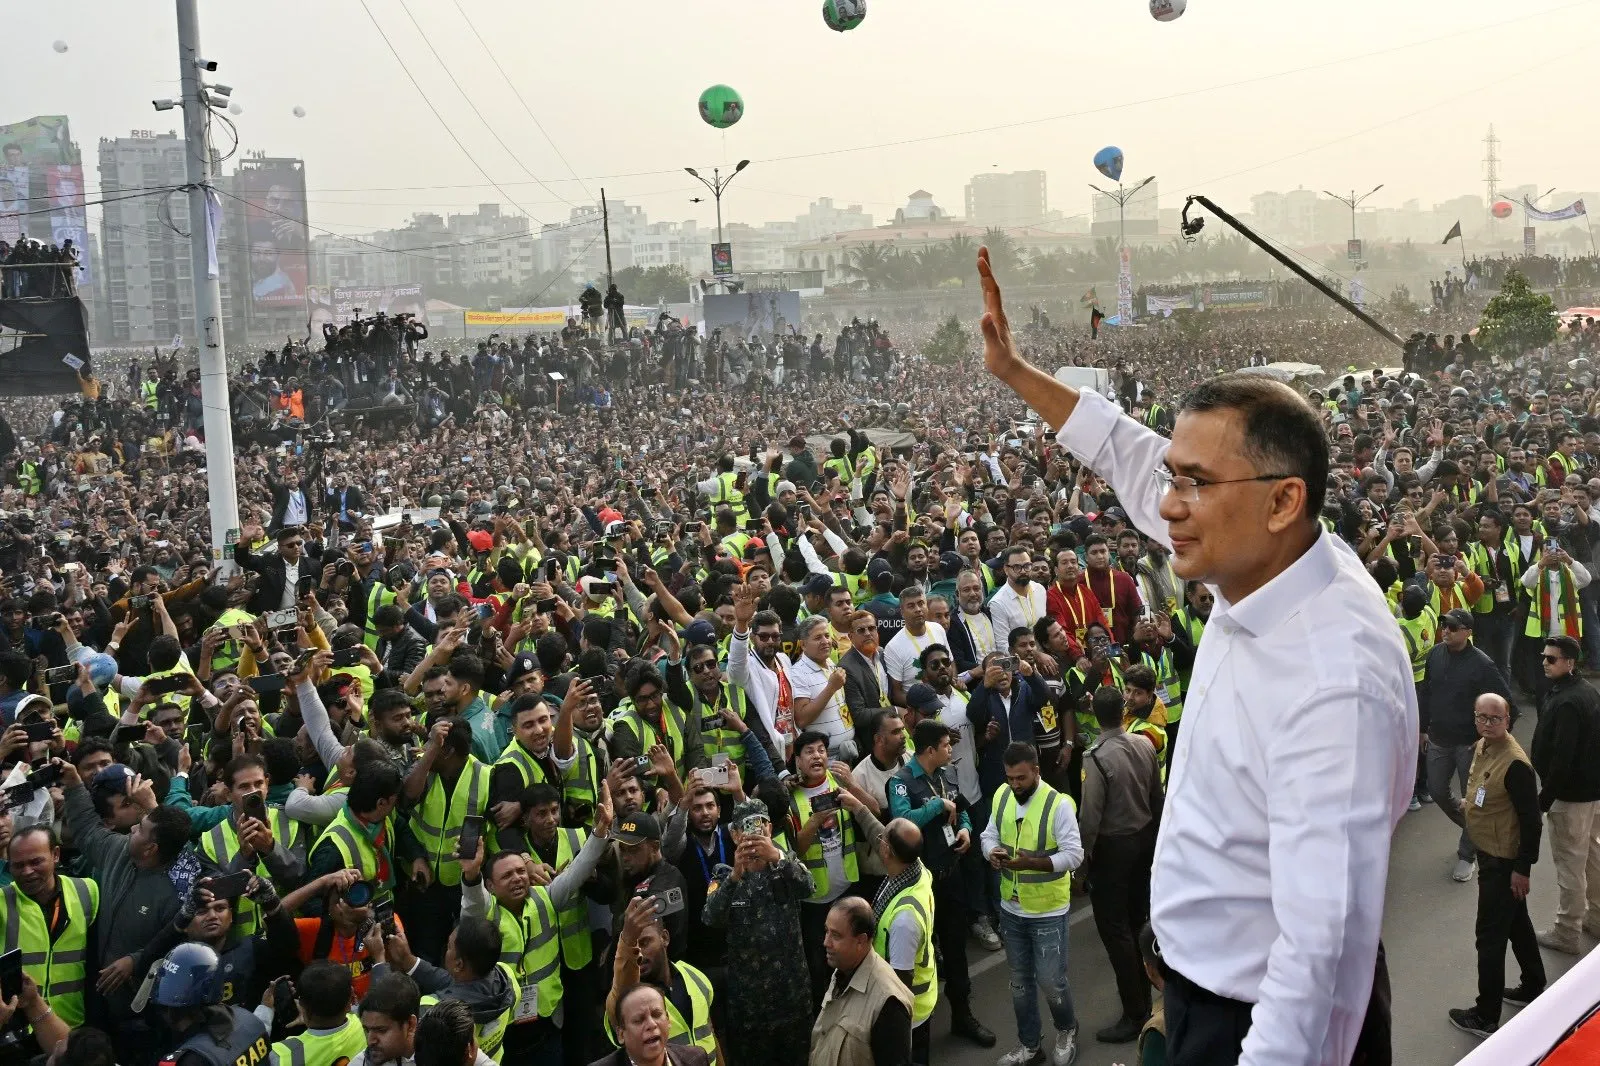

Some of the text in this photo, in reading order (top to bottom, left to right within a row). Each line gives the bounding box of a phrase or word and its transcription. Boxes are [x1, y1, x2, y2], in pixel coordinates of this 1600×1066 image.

[131, 130, 156, 138] RBL
[878, 620, 906, 628] POLICE
[236, 1037, 267, 1066] RAB
